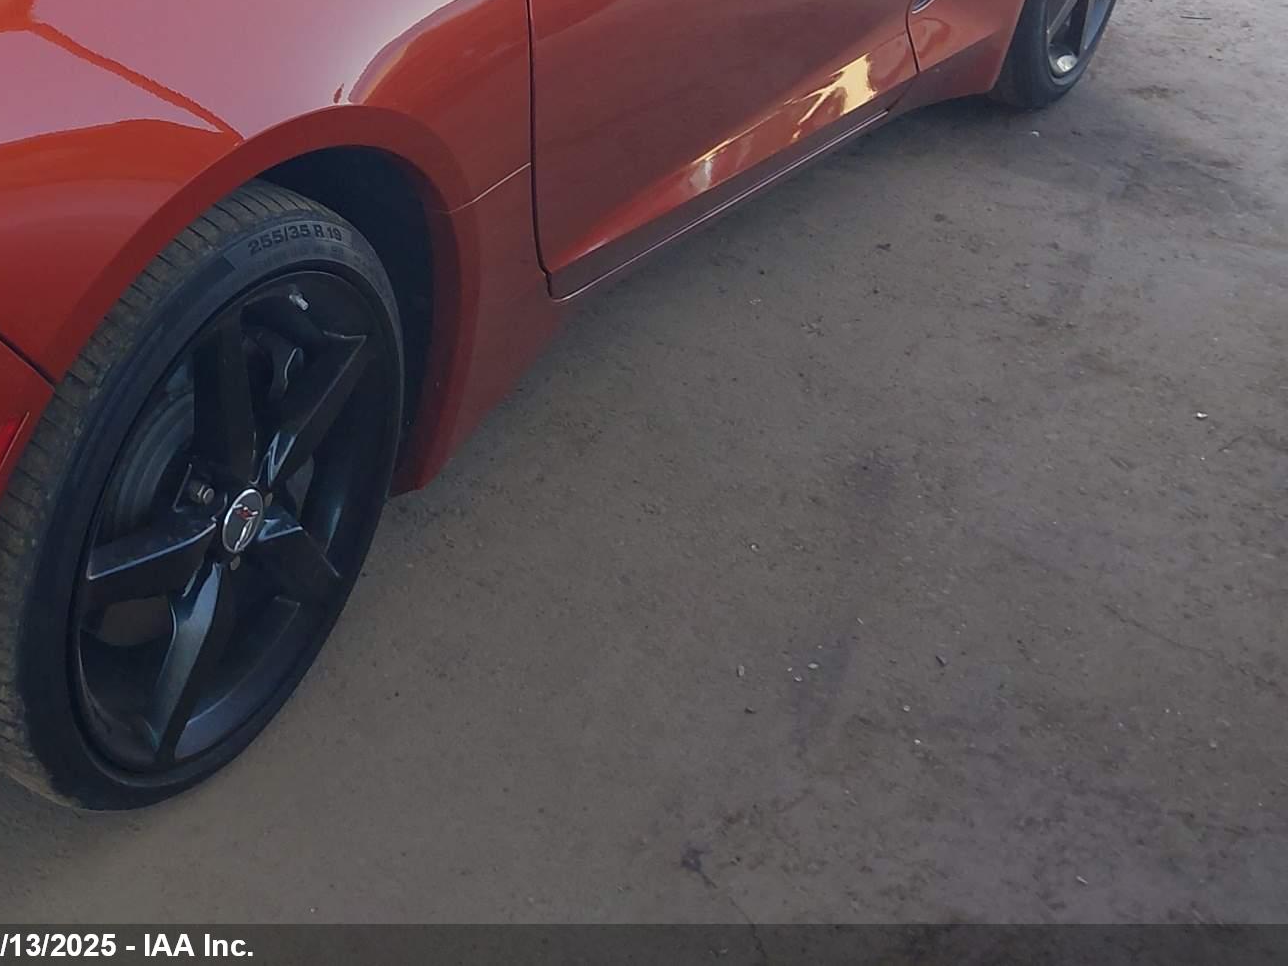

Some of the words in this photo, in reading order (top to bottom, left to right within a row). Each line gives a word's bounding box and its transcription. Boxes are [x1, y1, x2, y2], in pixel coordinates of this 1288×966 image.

[247, 224, 310, 255] 255/35
[312, 224, 325, 238] R
[327, 226, 343, 242] 19
